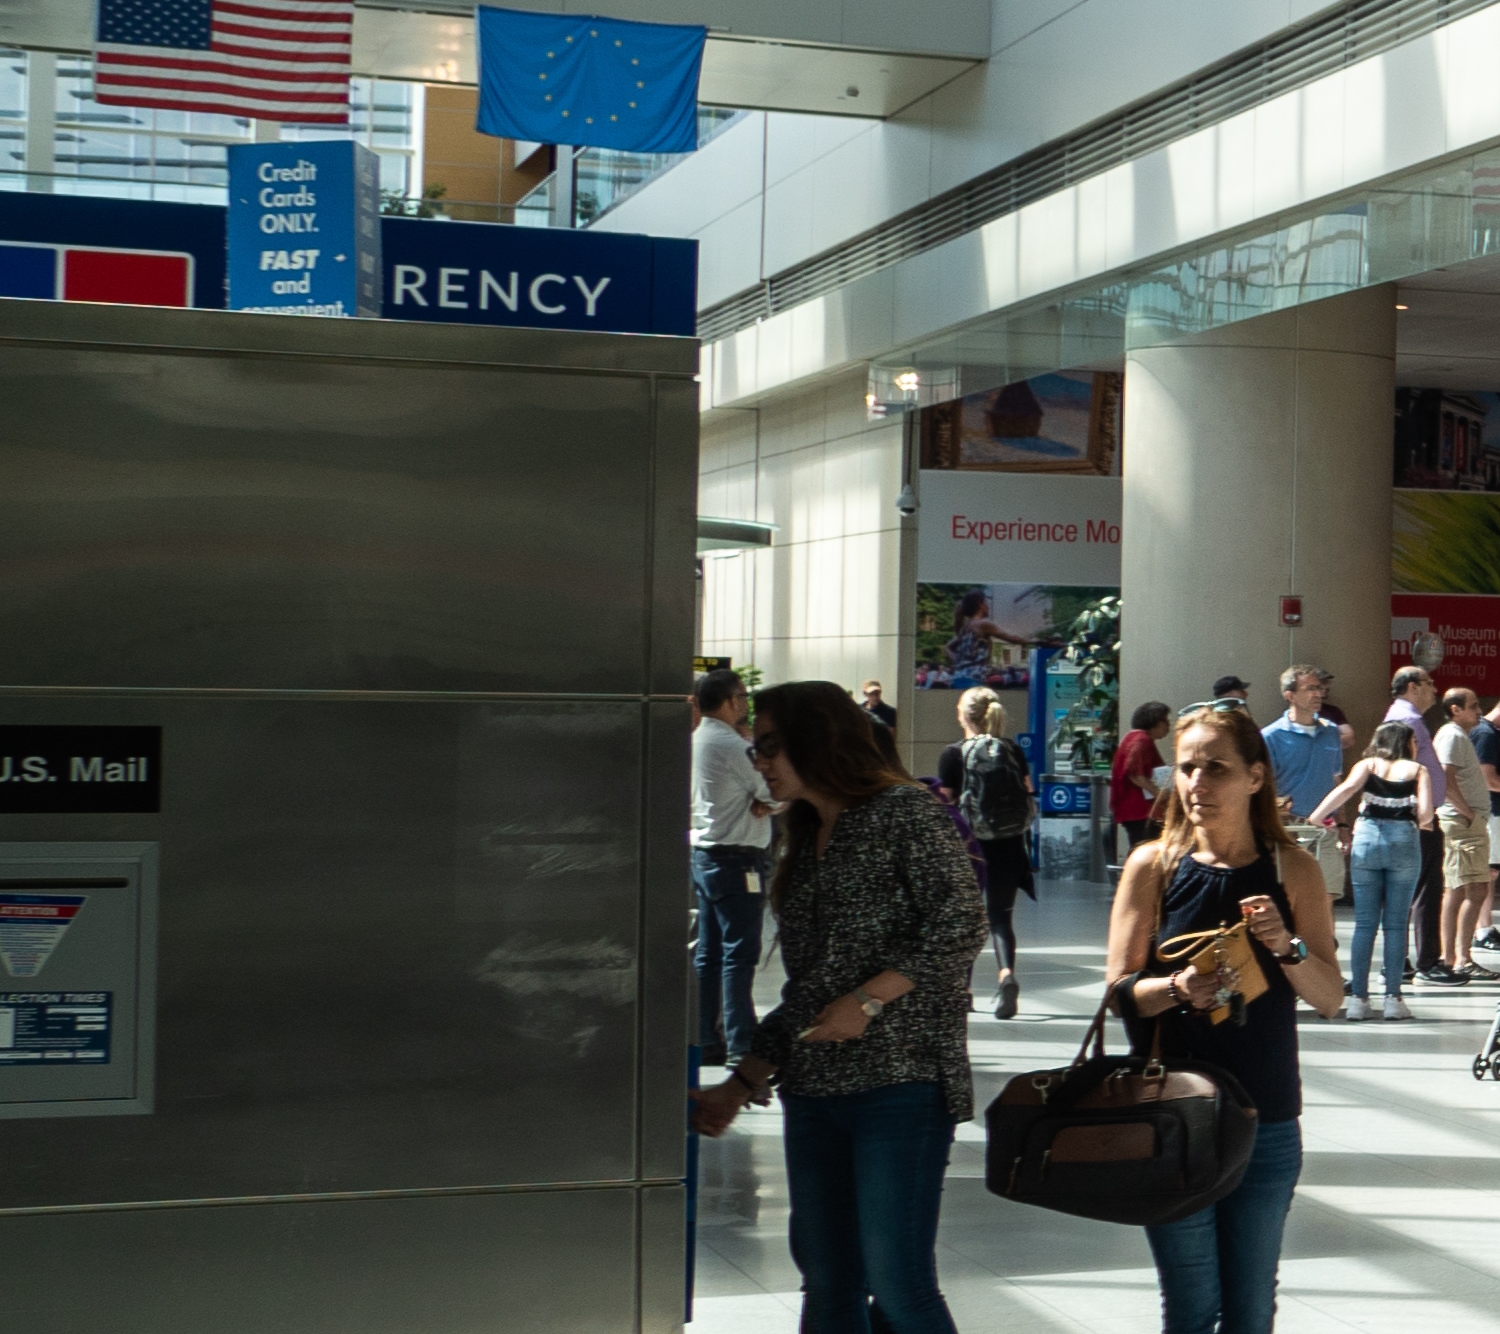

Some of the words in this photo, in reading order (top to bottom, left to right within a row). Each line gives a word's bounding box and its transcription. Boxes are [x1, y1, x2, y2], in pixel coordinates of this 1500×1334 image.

[259, 160, 317, 182] Credit
[259, 188, 317, 208] Cards
[259, 212, 319, 234] ONLY.
[260, 250, 320, 270] FAST
[272, 274, 311, 295] and
[394, 265, 612, 317] RENCY
[952, 515, 1077, 545] Experience
[1438, 624, 1496, 640] Museum
[1469, 643, 1497, 656] Arts
[1440, 664, 1487, 680] mfa.org
[70, 756, 148, 783] Mail
[64, 993, 106, 1003] TIMES
